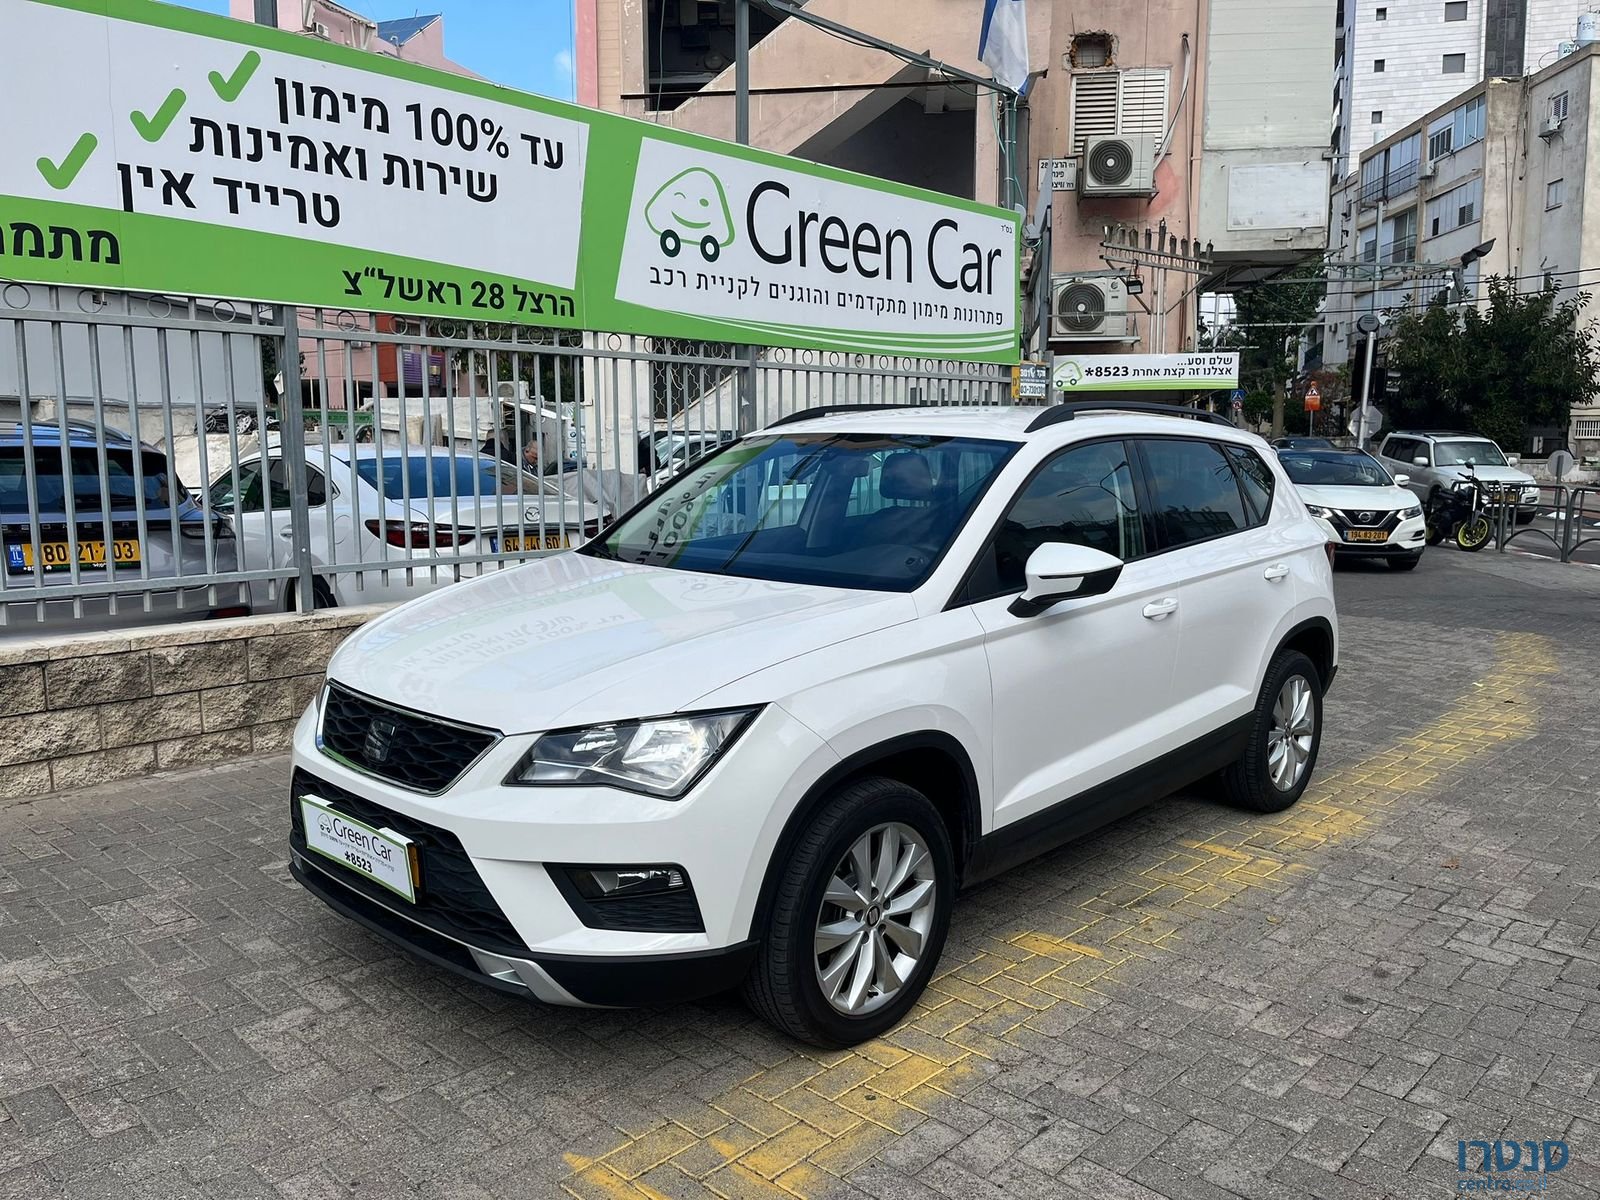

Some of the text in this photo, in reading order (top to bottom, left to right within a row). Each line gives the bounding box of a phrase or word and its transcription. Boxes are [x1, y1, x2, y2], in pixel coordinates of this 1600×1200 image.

[274, 77, 564, 169] עד 100% מימון
[189, 116, 498, 203] שירות ואמינות
[117, 162, 341, 228] טרייד אין
[746, 180, 1002, 295] Green Car
[342, 266, 575, 317] הרצל 28 ראשל"צ
[649, 266, 1003, 326] פתרונות מימון מתקדמים והוגנים לקניית רכב
[1132, 367, 1161, 377] אחרת
[1163, 367, 1185, 378] קצת
[1188, 367, 1200, 376] זה
[1203, 366, 1232, 376] אצלנו
[1209, 356, 1233, 365] שלם
[333, 817, 371, 851] Green
[371, 836, 392, 862] Car
